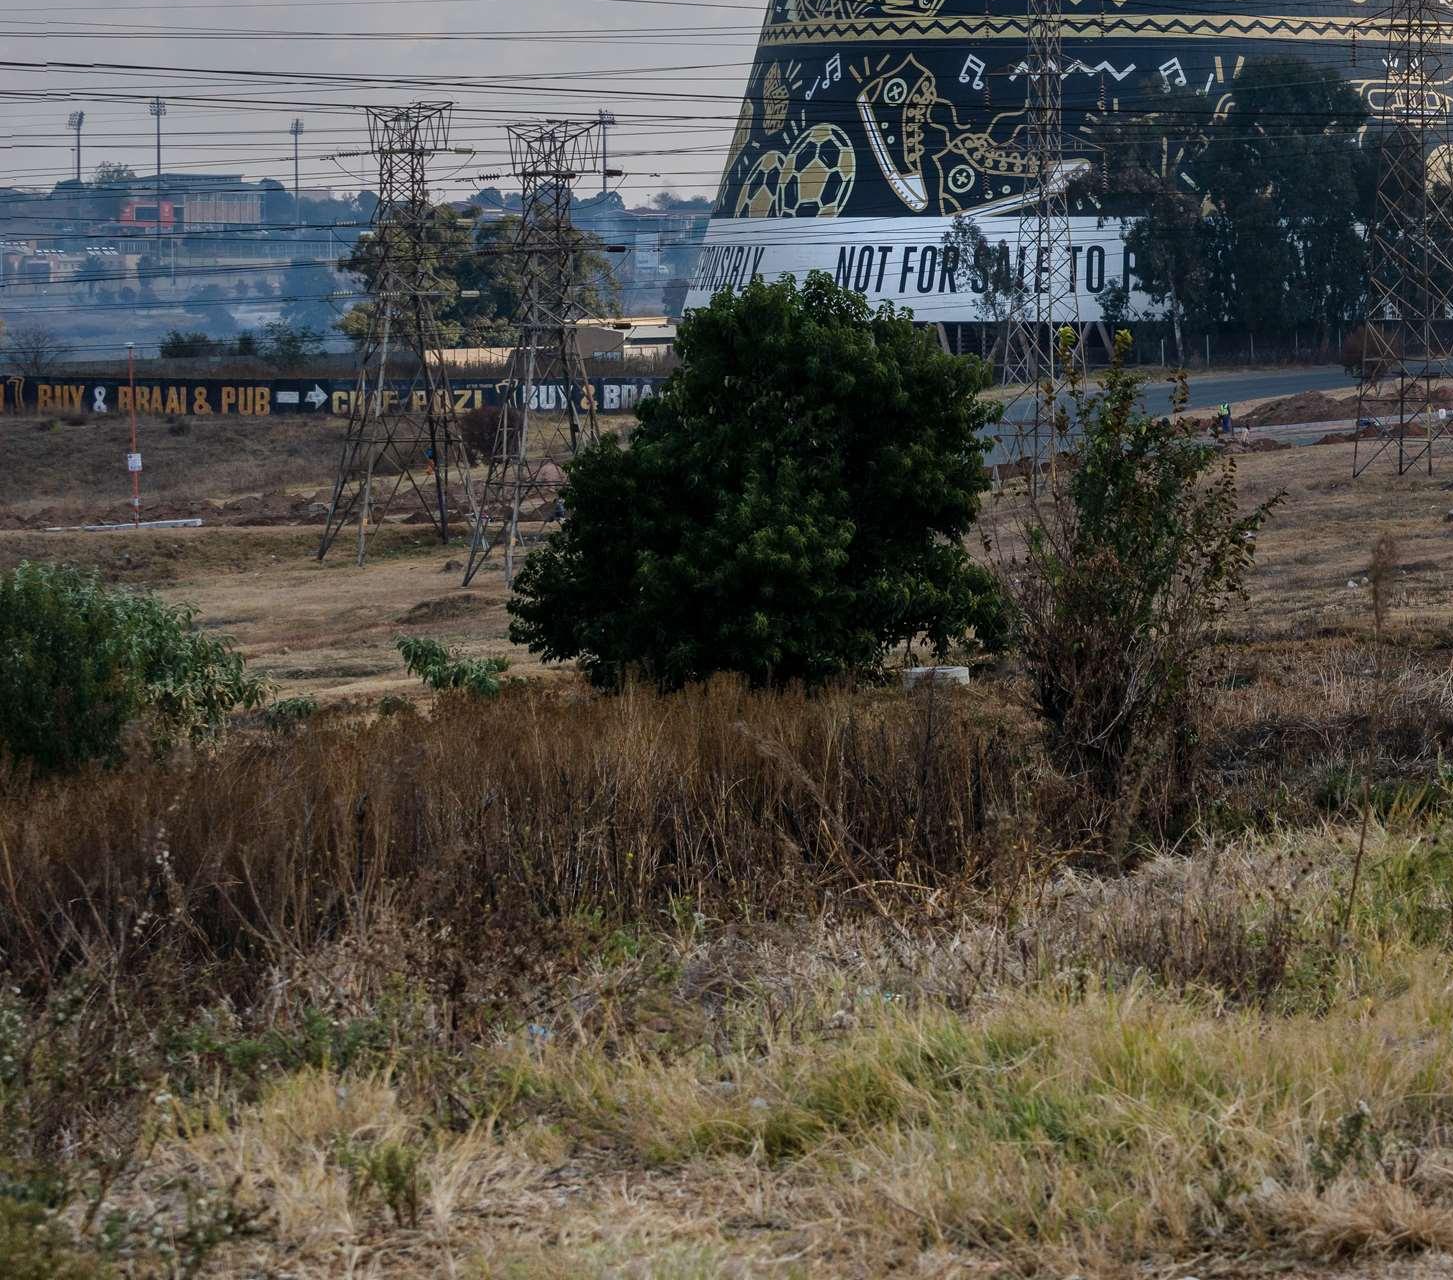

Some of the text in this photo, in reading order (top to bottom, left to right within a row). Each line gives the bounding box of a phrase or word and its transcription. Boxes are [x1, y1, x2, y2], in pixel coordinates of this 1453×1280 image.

[835, 245, 893, 293] NOT
[899, 245, 960, 293] FOR
[1066, 246, 1105, 293] TO
[37, 384, 85, 413] BUY
[92, 385, 107, 413] &
[193, 386, 213, 416] &
[221, 386, 271, 416] PUB
